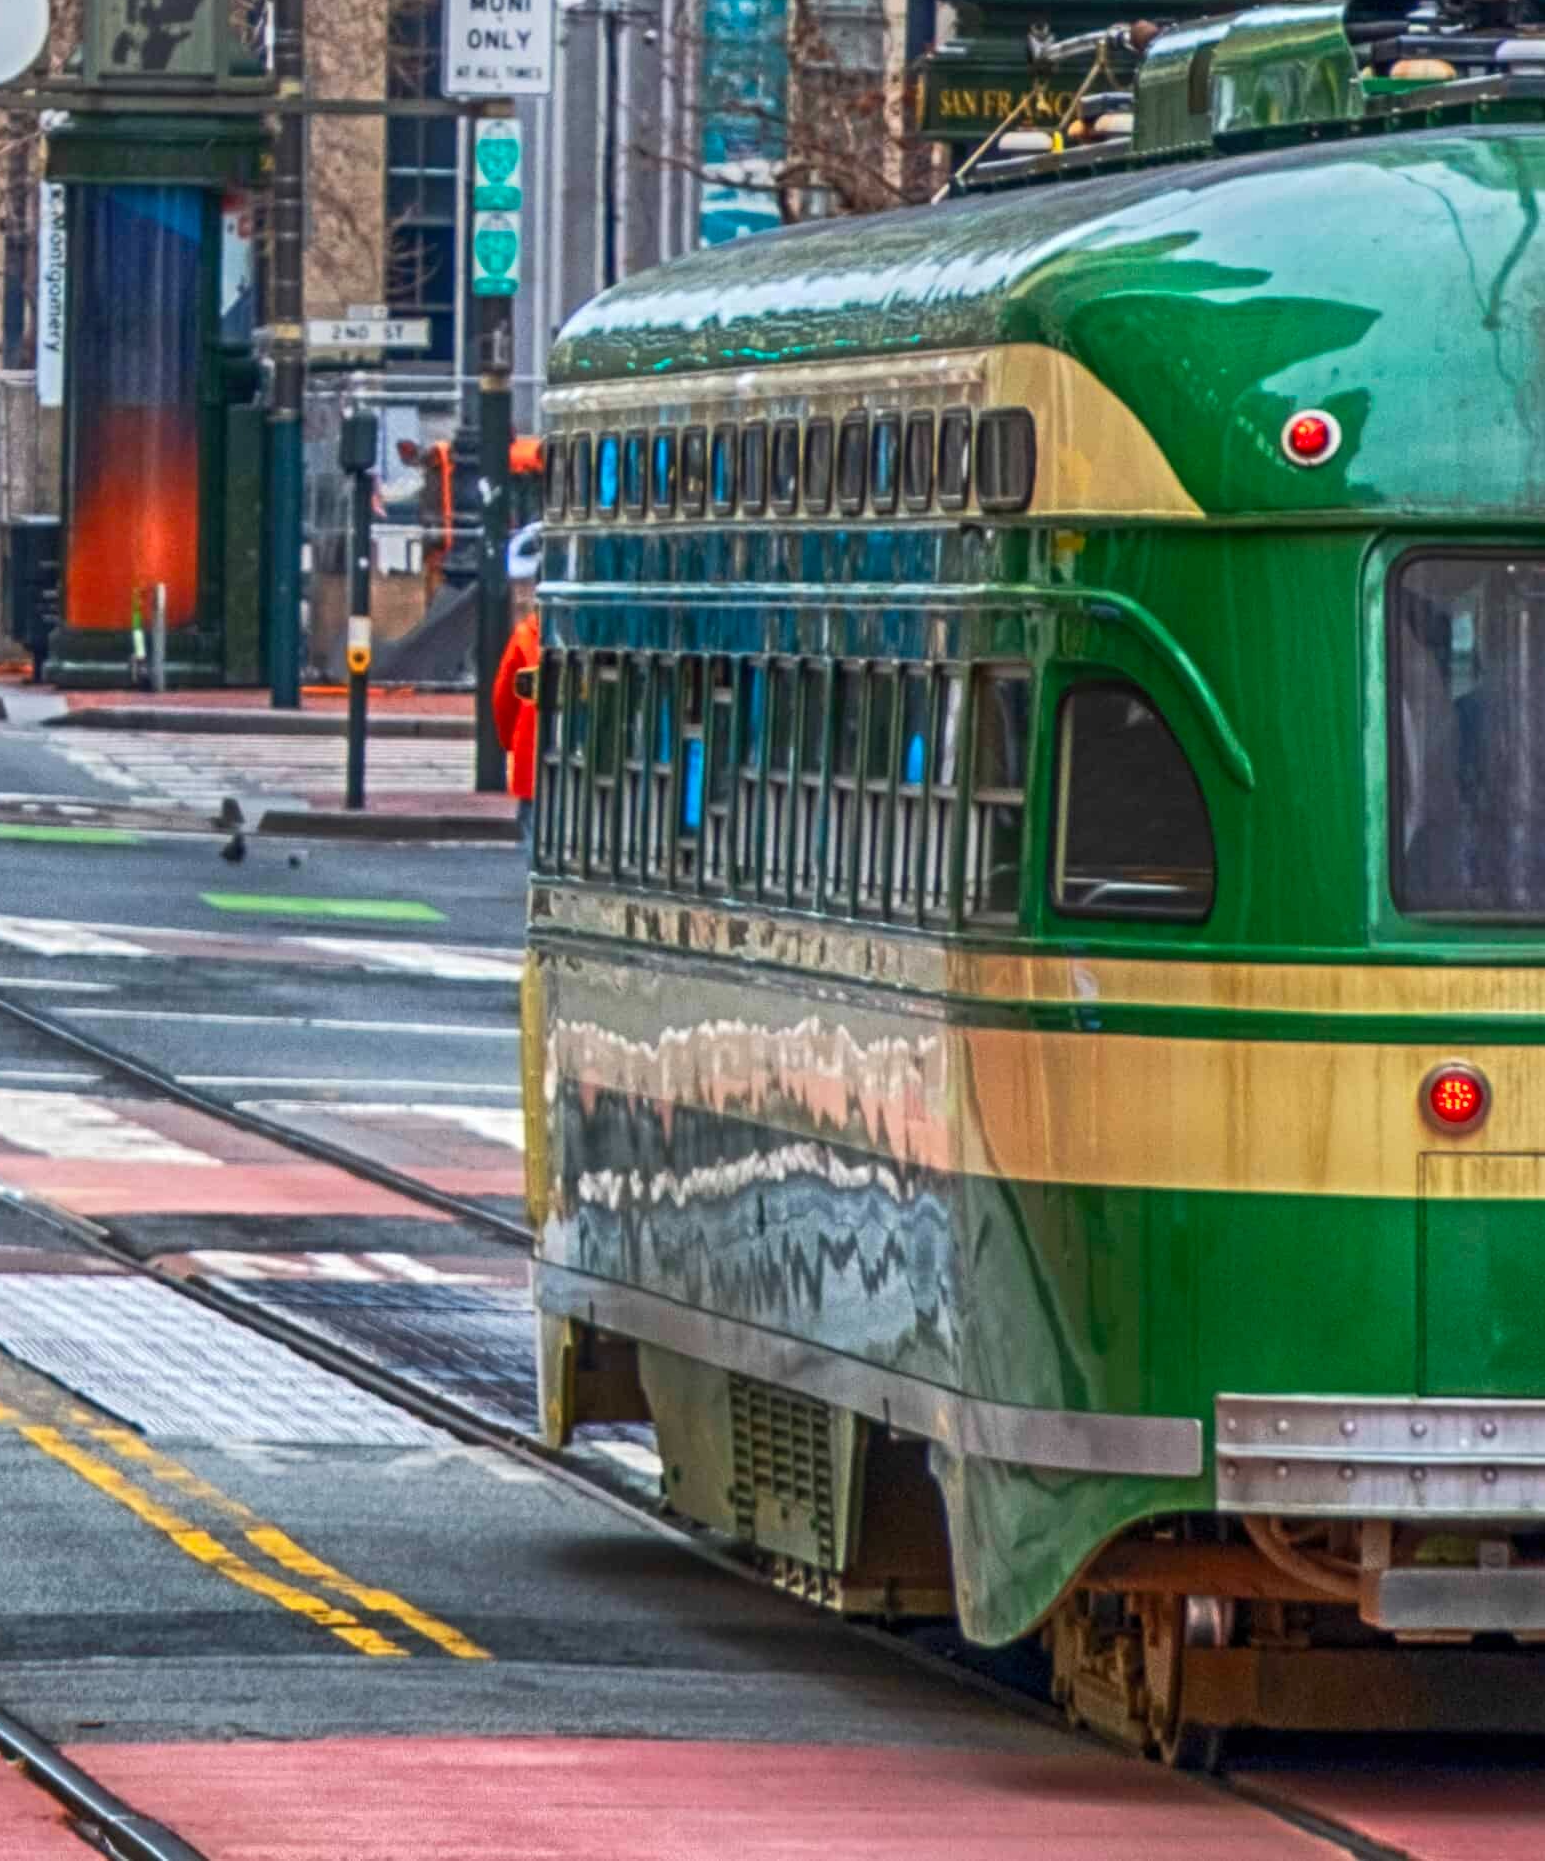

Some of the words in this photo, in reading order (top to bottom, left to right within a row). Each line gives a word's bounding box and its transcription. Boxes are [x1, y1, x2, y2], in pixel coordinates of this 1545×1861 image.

[467, 28, 532, 50] ONLY
[455, 65, 470, 78] AT
[476, 66, 498, 79] ALL
[505, 67, 543, 79] TIMES
[939, 90, 978, 116] SAN
[45, 209, 65, 353] Montgomery
[330, 322, 370, 340] 2ND
[385, 322, 404, 340] ST
